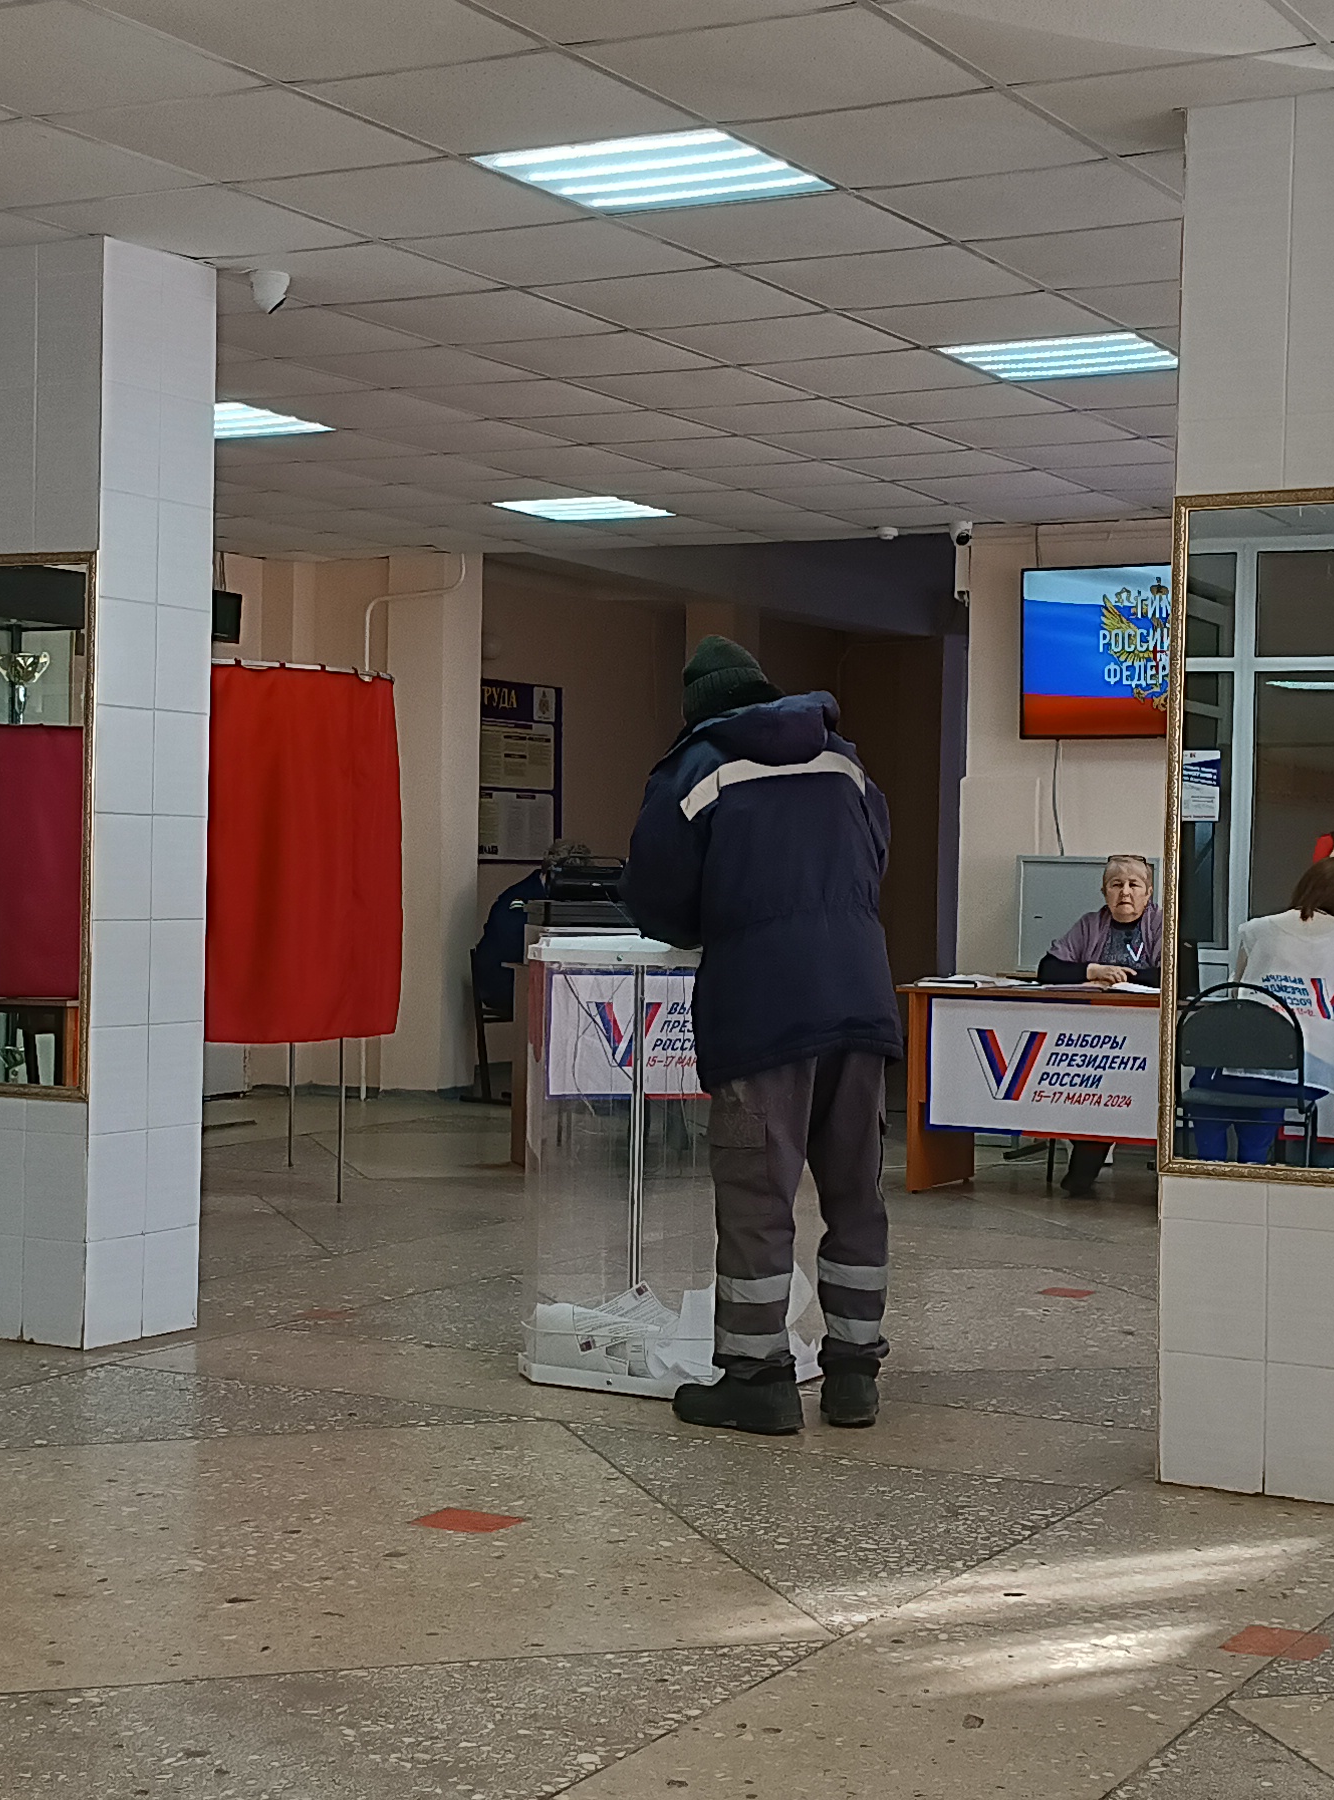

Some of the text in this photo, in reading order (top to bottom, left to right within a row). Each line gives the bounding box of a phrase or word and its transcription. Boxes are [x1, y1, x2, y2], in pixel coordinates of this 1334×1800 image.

[1055, 1033, 1127, 1050] ВЫБОРЫ
[1046, 1052, 1147, 1071] ПРЕЗИДЕНТА
[1038, 1072, 1103, 1089] РОССИИ
[1063, 1093, 1102, 1107] МАРТА
[1104, 1095, 1132, 1108] 2024
